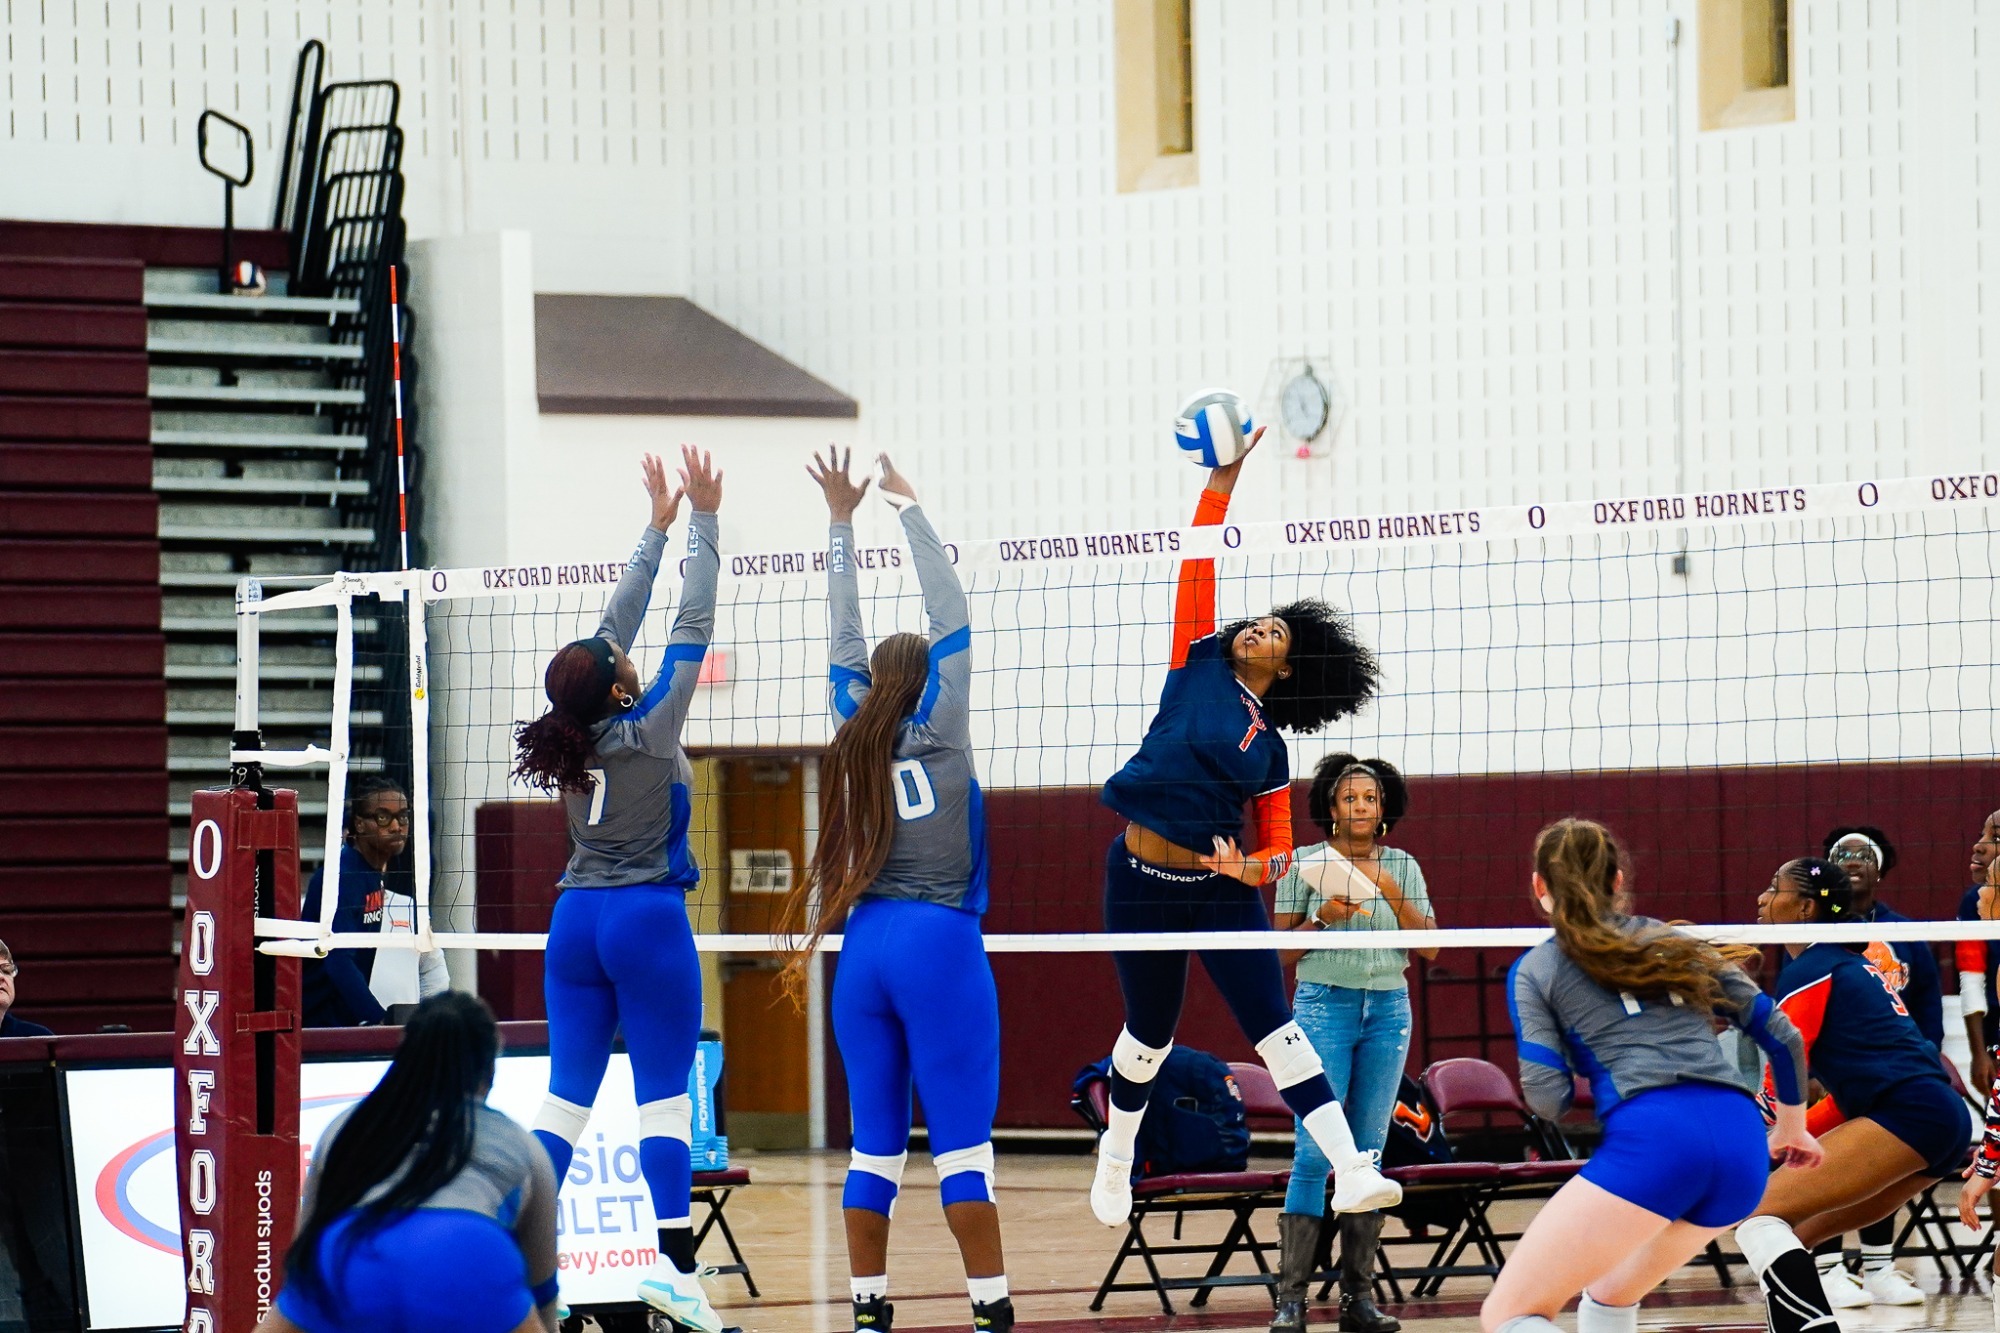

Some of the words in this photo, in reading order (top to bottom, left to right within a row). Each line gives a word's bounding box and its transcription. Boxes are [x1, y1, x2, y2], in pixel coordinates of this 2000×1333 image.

[432, 571, 447, 593] O
[483, 566, 552, 589] OXFORD
[557, 563, 628, 585] HORNET
[732, 552, 804, 576] OXFORD
[812, 547, 901, 571] HNETS
[1000, 537, 1079, 562] OXFORD
[1084, 531, 1180, 556] HORNETS
[1223, 526, 1241, 549] O
[1285, 518, 1370, 544] OXFORD
[1378, 511, 1480, 539] HORNETS
[1527, 505, 1546, 529] O
[1594, 497, 1686, 524] OXFORD
[1695, 488, 1806, 518] HORNETS
[1857, 482, 1879, 507] O
[1931, 474, 1999, 500] OXFO
[832, 536, 844, 573] ECSU
[1141, 864, 1207, 882] ARMOUR
[695, 1049, 709, 1131] POWERADE
[254, 1170, 273, 1238] sports
[253, 1241, 272, 1324] imports
